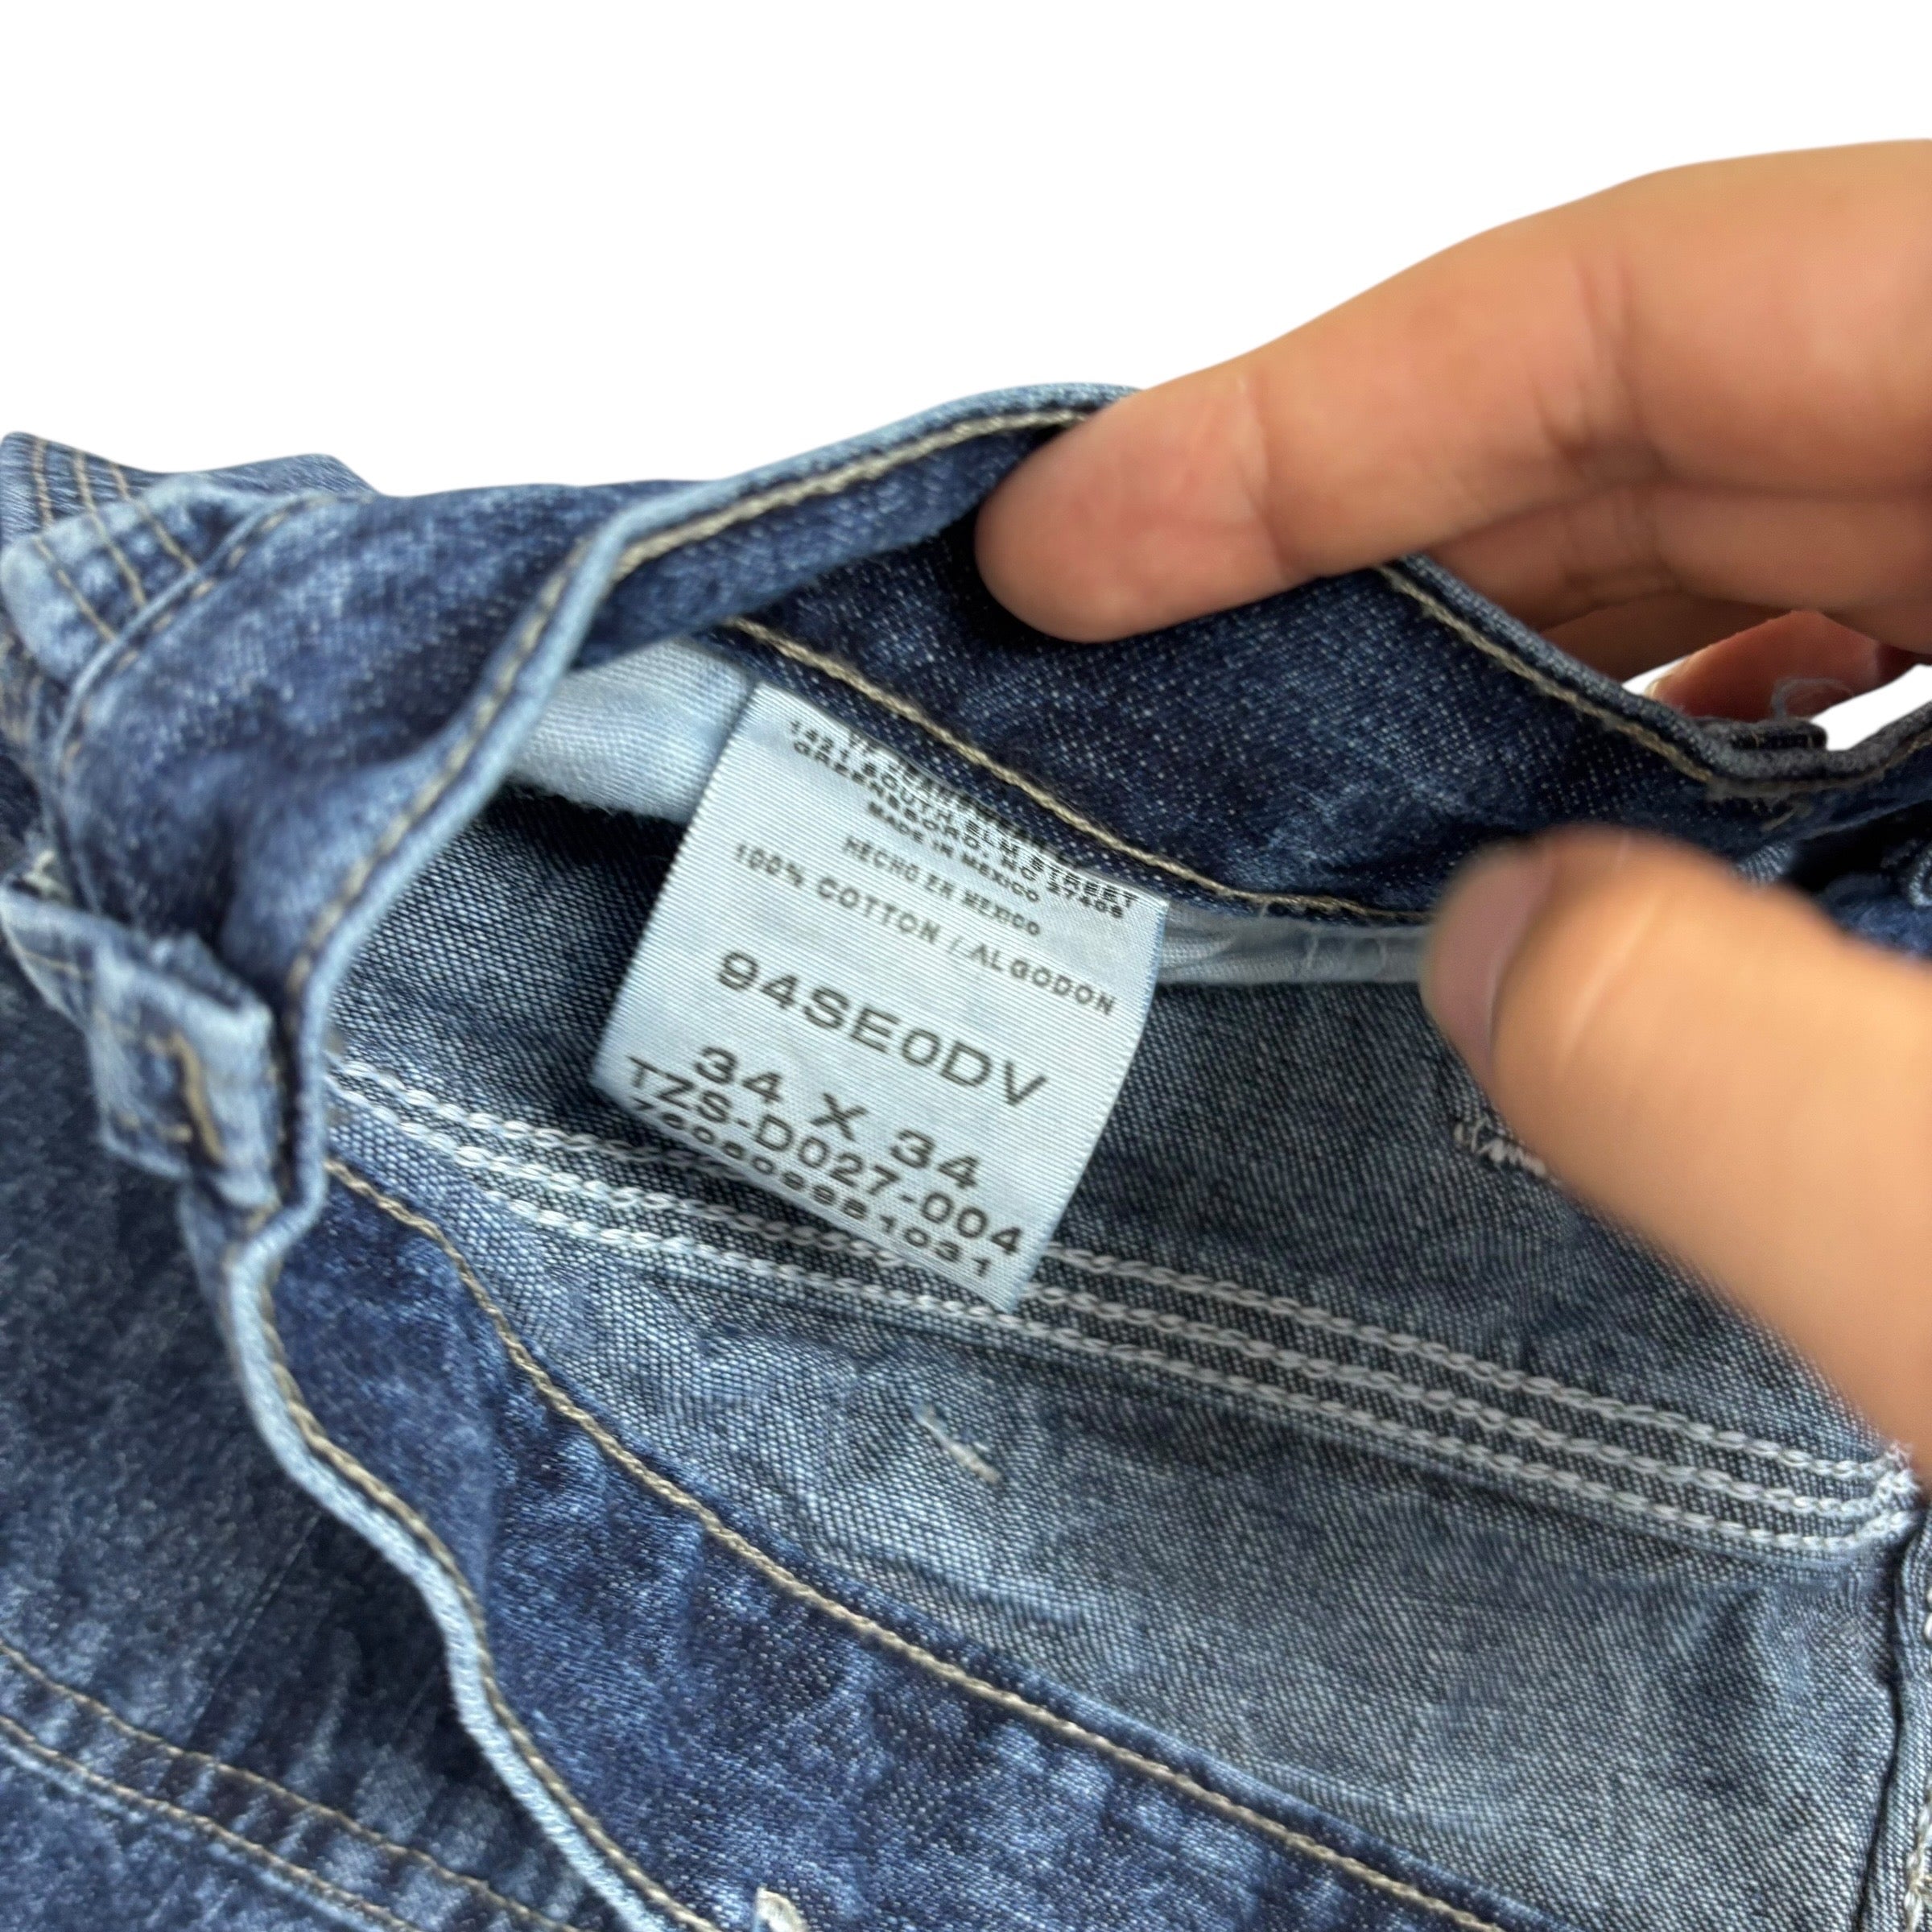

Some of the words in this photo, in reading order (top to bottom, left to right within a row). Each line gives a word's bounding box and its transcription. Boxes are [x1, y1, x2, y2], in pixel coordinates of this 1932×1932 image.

[790, 720, 850, 762] 1421
[861, 761, 954, 824] SOUTH
[965, 819, 1020, 858] ELM
[1030, 855, 1139, 908] STREET
[844, 835, 919, 882] HECHO
[925, 873, 957, 900] EN
[962, 889, 1041, 936] MEXICO
[868, 801, 924, 844] MADE
[932, 840, 956, 859] IN
[960, 851, 1040, 903] MEXICO
[1001, 854, 1038, 882] NC
[736, 843, 805, 888] 100%
[815, 876, 942, 946] COTTON
[948, 935, 964, 955] /
[969, 943, 1117, 1017] ALGODON
[625, 1055, 1024, 1257] TZS-D027-004
[694, 1046, 783, 1104] 34
[810, 1092, 869, 1141] X
[890, 1129, 982, 1190] 34
